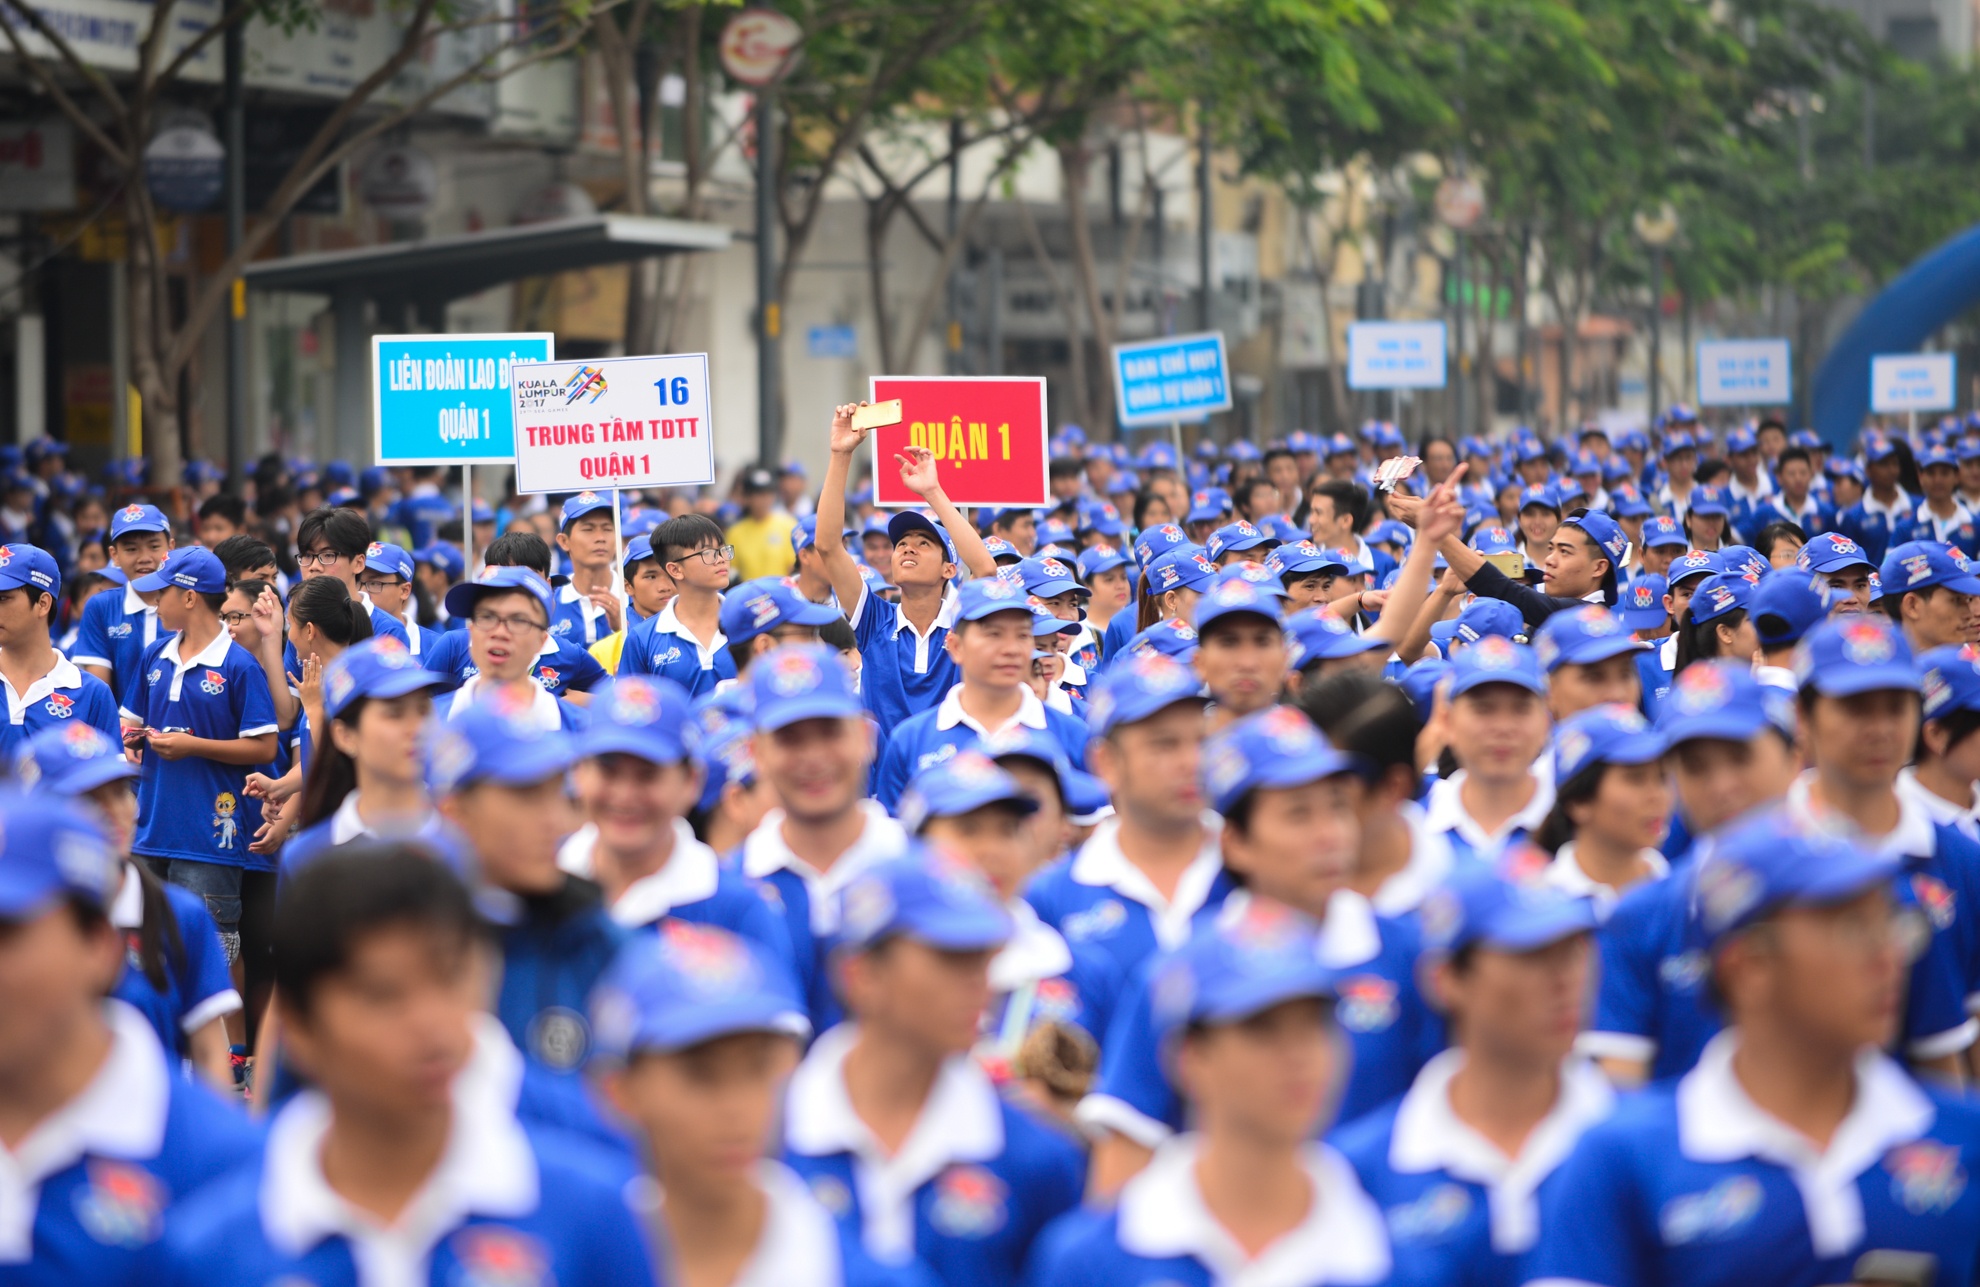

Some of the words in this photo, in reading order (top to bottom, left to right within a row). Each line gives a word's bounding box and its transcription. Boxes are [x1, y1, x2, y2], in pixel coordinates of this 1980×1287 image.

[390, 353, 422, 390] LIÊN
[425, 352, 465, 390] ĐOÀN
[469, 358, 496, 390] LAO
[518, 379, 558, 389] KUALA
[518, 388, 566, 398] LUMPUR
[520, 398, 546, 408] 2017
[654, 376, 690, 406] 16
[438, 401, 479, 446] QUẬN
[482, 408, 490, 439] 1
[526, 423, 595, 447] TRUNG
[600, 418, 644, 442] TÂM
[648, 418, 699, 440] TDTT
[998, 423, 1010, 460] 1
[580, 452, 635, 482] QUẬN
[640, 454, 650, 474] 1
